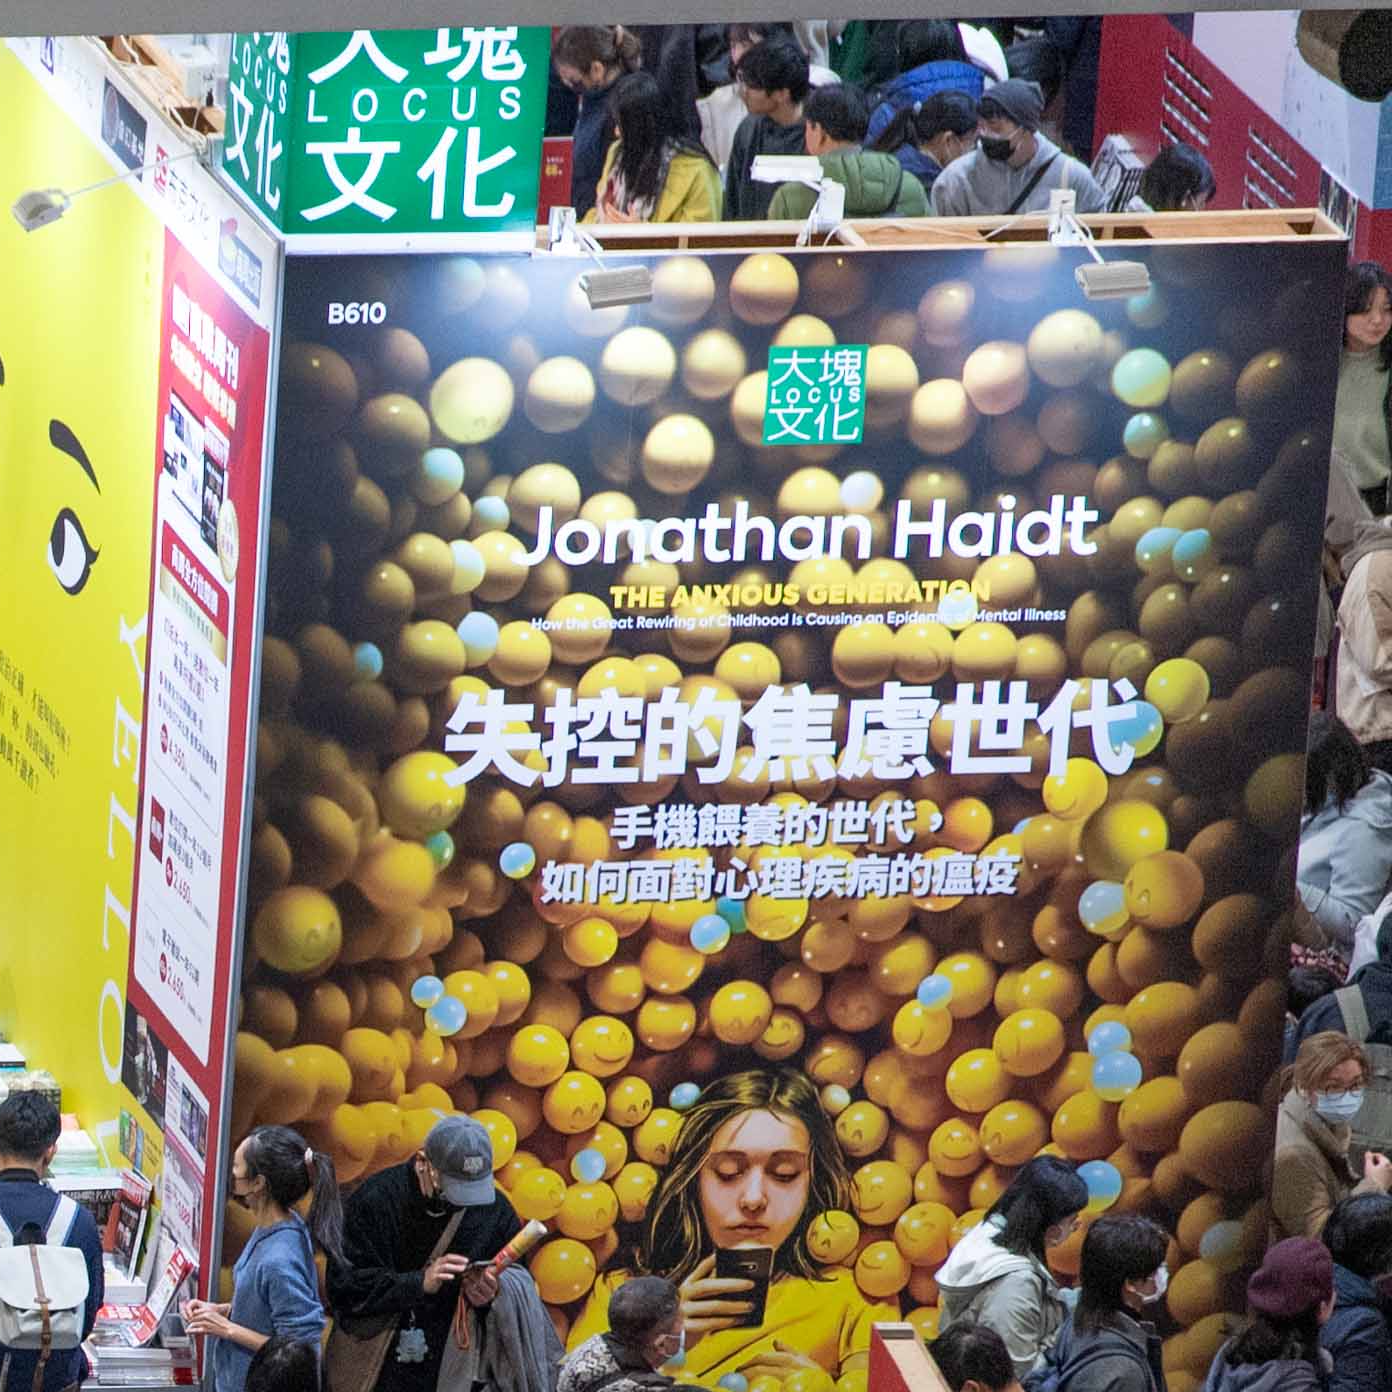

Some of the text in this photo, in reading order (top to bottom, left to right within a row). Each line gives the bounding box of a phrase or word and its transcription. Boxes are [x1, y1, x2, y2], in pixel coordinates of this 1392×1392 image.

[232, 31, 288, 114] LOCUS
[307, 86, 521, 122] LOCUS
[225, 77, 283, 211] 文化
[300, 126, 517, 222] 文化
[328, 303, 387, 325] B610
[771, 349, 862, 388] 大塊
[770, 386, 861, 404] LOCUS
[767, 403, 860, 441] 文化
[512, 494, 1099, 566] Jonathan Haidt
[610, 578, 992, 609] THE ANXIOUS GENERATION
[530, 616, 562, 632] How
[565, 616, 591, 631] the
[591, 615, 634, 630] Great
[636, 613, 698, 632] Rewiring
[700, 612, 716, 629] of
[717, 612, 790, 629] Childhood
[792, 611, 804, 627] Is
[805, 610, 864, 632] Causing
[866, 613, 885, 627] an
[973, 608, 1022, 624] Mental
[1024, 607, 1067, 623] Illness
[443, 679, 1139, 789] 失控的焦慮世代
[541, 851, 1023, 905] 如何面對心理疾病的瘟疫
